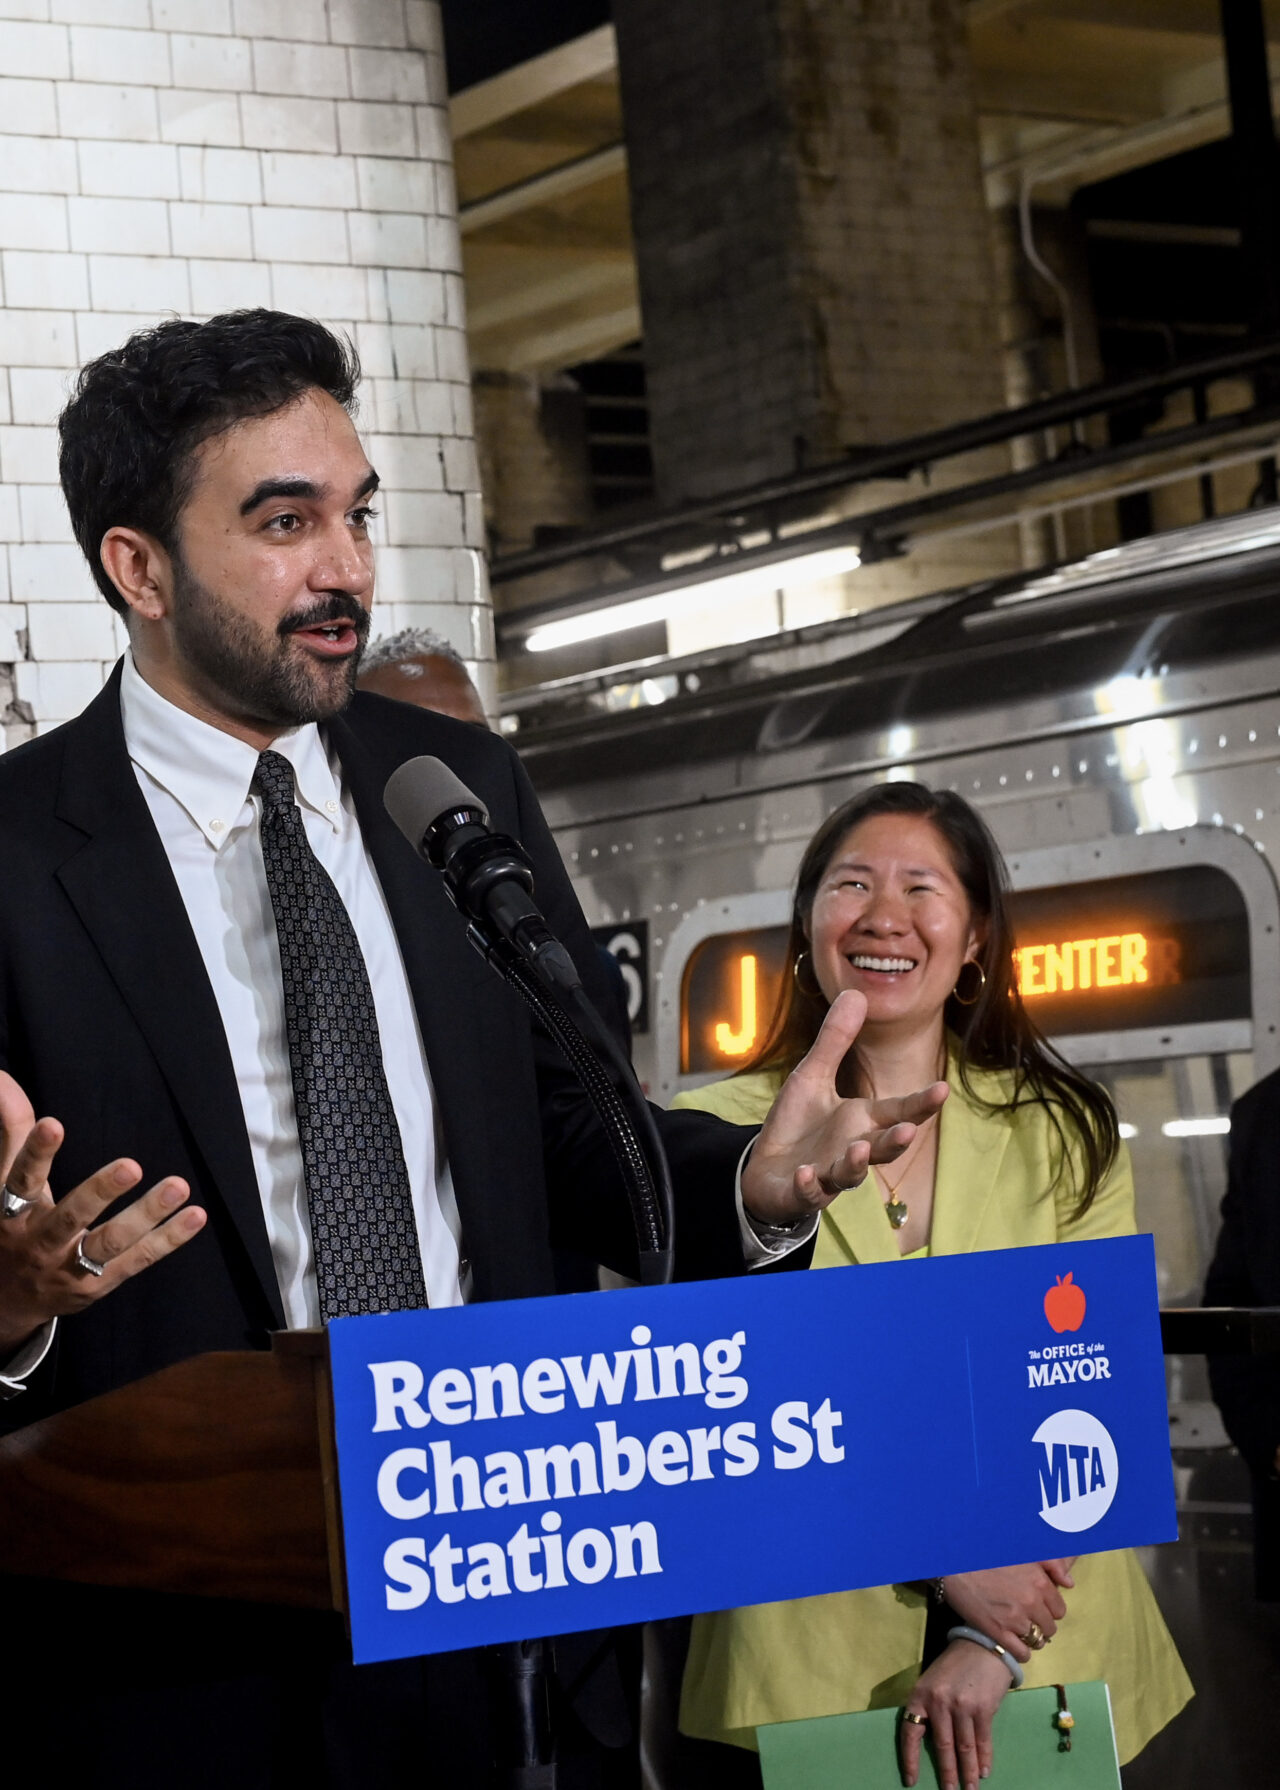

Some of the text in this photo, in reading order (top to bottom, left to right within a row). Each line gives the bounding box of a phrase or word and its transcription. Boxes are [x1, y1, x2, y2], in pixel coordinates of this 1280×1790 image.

[715, 954, 757, 1055] J
[1008, 932, 1148, 996] ENTER
[368, 1325, 749, 1433] Renewing
[1026, 1356, 1112, 1389] MAYOR
[1028, 1342, 1105, 1360] The OFFICE of the
[377, 1398, 846, 1520] Chambers St
[1037, 1441, 1107, 1510] MTA
[383, 1511, 663, 1612] Station
